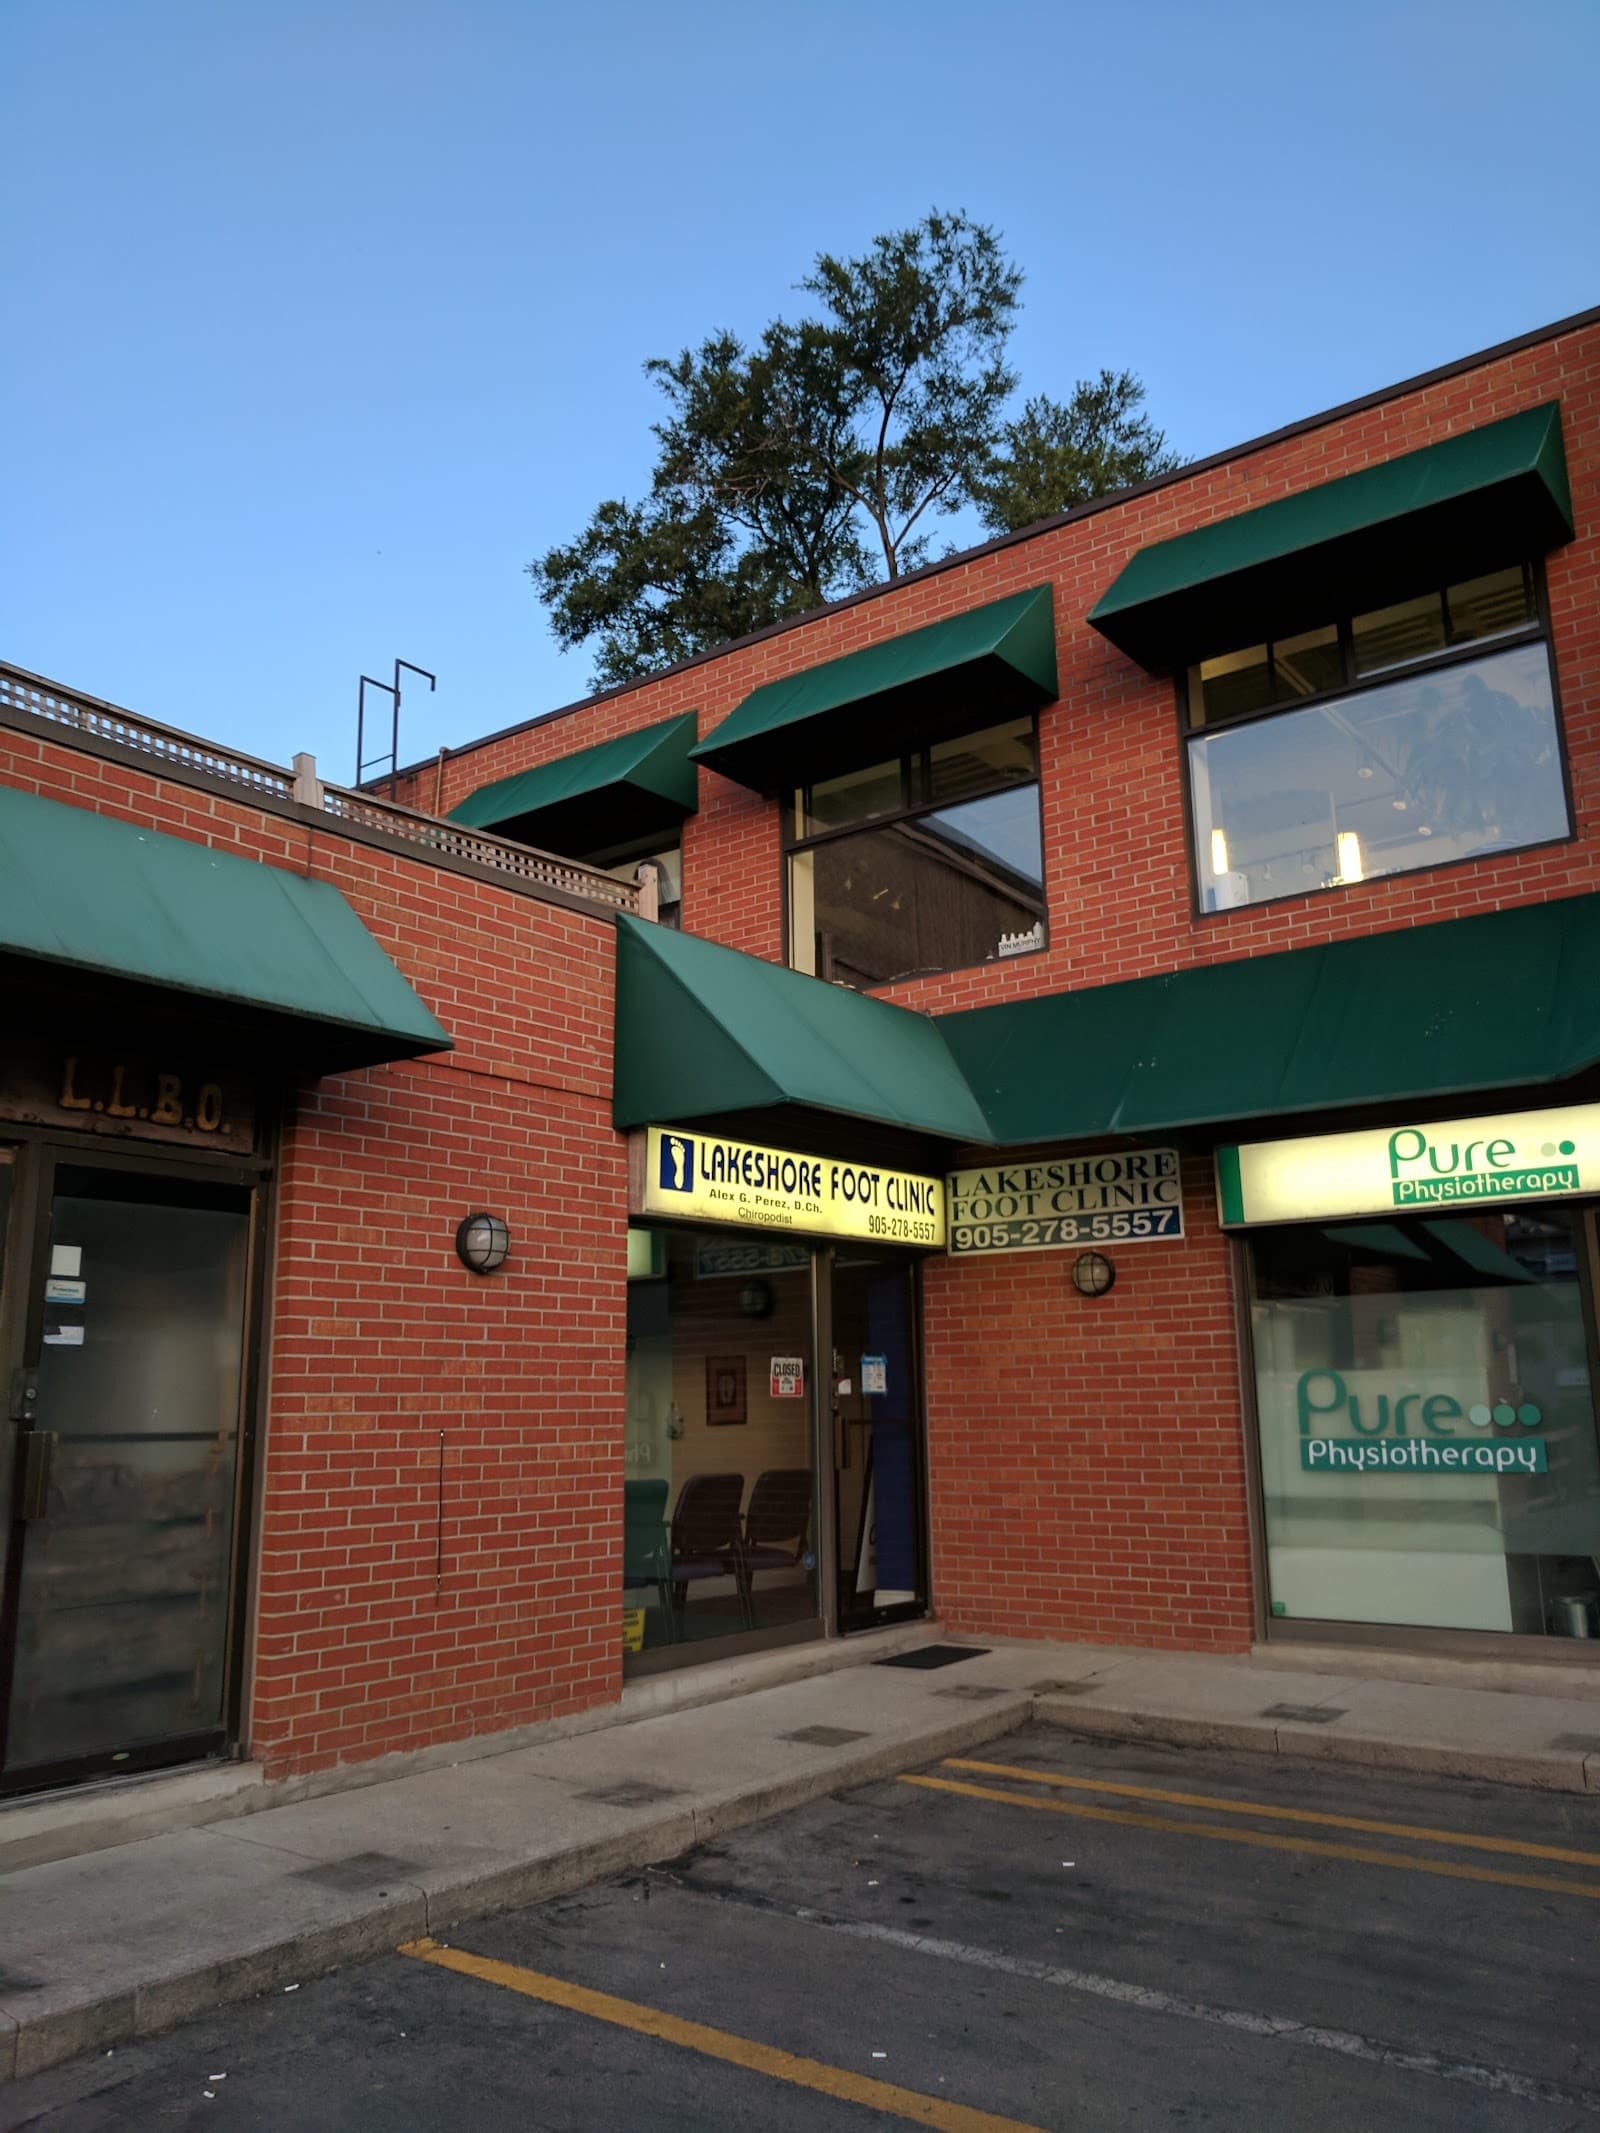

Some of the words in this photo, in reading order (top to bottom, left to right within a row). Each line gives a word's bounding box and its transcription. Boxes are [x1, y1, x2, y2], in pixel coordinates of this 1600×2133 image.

[1388, 1128, 1516, 1178] Pure
[700, 1142, 822, 1198] LAKESHORE
[830, 1166, 880, 1206] FOOT
[886, 1176, 936, 1216] CLINIC
[951, 1151, 1178, 1198] LAKESHORE
[1399, 1168, 1574, 1201] Physiotherapy
[709, 1189, 735, 1202] Alex
[739, 1193, 751, 1204] G.
[755, 1195, 791, 1211] Perez,
[794, 1200, 823, 1214] D.Ch.
[738, 1207, 793, 1225] Chiropodist
[952, 1193, 1041, 1221] FOOT
[1050, 1179, 1179, 1213] CLINIC
[868, 1214, 936, 1241] 905-278-5557
[955, 1209, 1174, 1250] 905-278-5557
[774, 1363, 800, 1377] CLOSED
[1296, 1368, 1463, 1436] Pure
[1308, 1439, 1538, 1472] Physiotherapy
